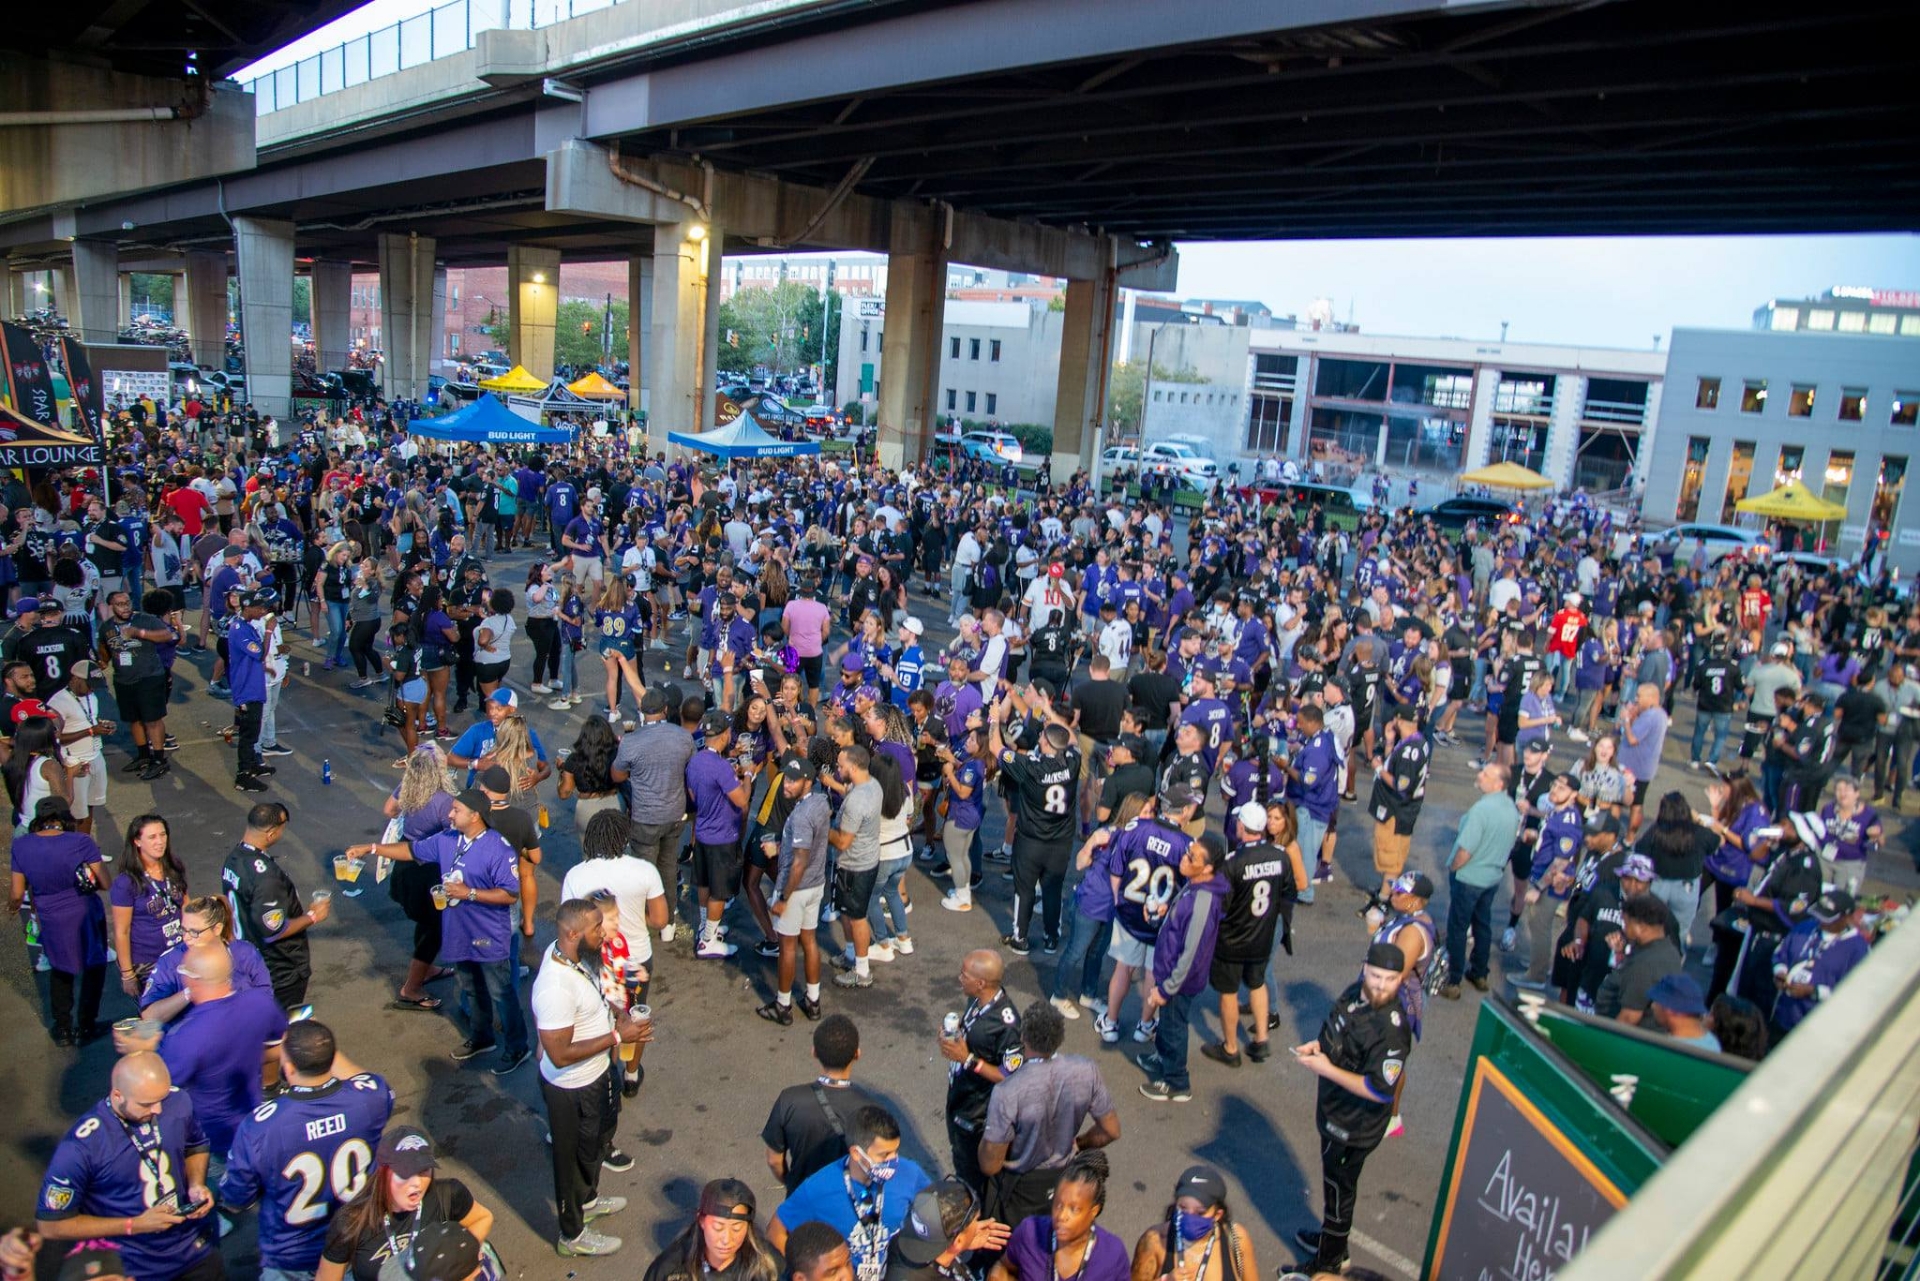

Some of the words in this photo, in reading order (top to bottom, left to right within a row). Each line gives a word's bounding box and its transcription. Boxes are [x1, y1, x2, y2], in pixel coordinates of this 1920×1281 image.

[31, 389, 50, 420] SPAR
[488, 431, 508, 439] BUD
[509, 432, 536, 440] LIGHT
[24, 446, 101, 464] LOUNGE
[559, 493, 567, 507] 8
[133, 531, 140, 547] 8
[1043, 589, 1061, 606] 10
[603, 616, 626, 638] 89
[36, 643, 65, 654] JACKSON
[1048, 638, 1056, 652] 8
[45, 655, 60, 679] 8
[1364, 682, 1376, 708] 9
[1209, 724, 1220, 749] 8
[1041, 769, 1070, 784] JACKSON
[1045, 785, 1068, 815] 8
[1146, 835, 1172, 858] REED
[254, 859, 267, 874] 8
[1243, 861, 1282, 881] JACKSON
[1123, 858, 1175, 905] 20
[1251, 880, 1272, 917] 8
[1001, 1007, 1016, 1024] 8
[76, 1117, 100, 1139] 8
[306, 1113, 347, 1142] REED
[138, 1149, 177, 1209] 8
[282, 1138, 374, 1226] 20
